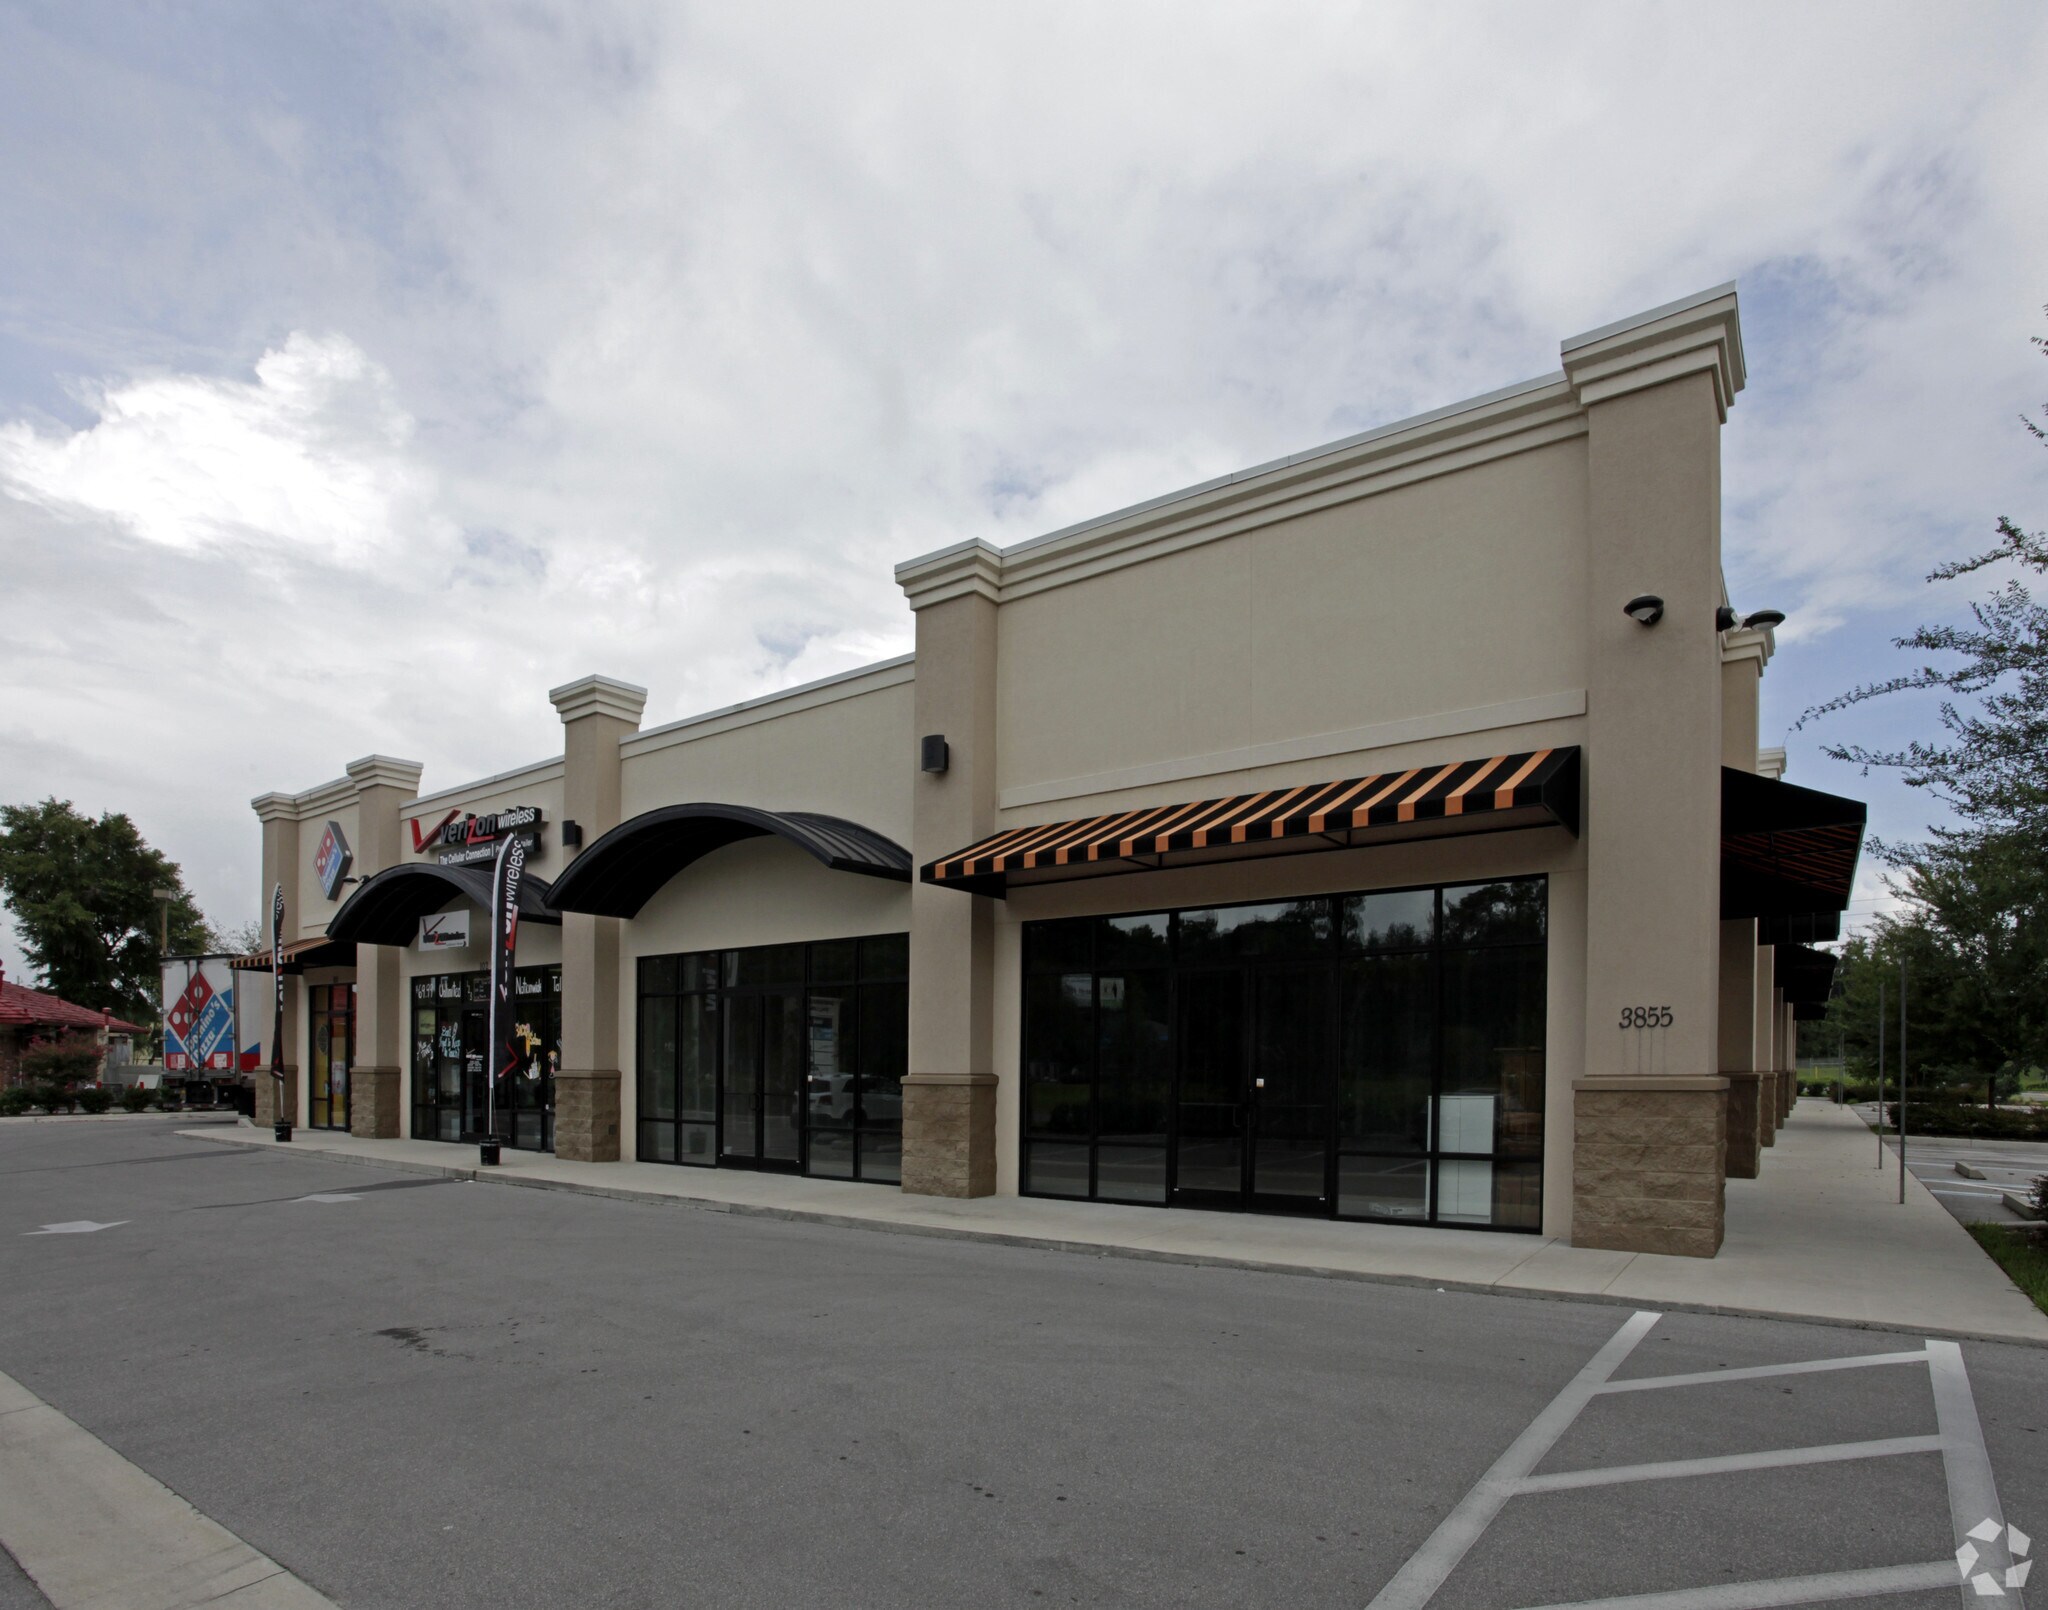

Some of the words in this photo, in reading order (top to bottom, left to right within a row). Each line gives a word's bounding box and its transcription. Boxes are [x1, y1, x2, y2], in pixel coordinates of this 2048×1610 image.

[440, 813, 496, 845] verizon
[497, 808, 535, 829] wireless
[440, 856, 448, 865] The
[448, 852, 466, 864] Cellular
[465, 848, 491, 860] Connection
[186, 1000, 220, 1052] Domino's
[1618, 1005, 1674, 1029] 3855
